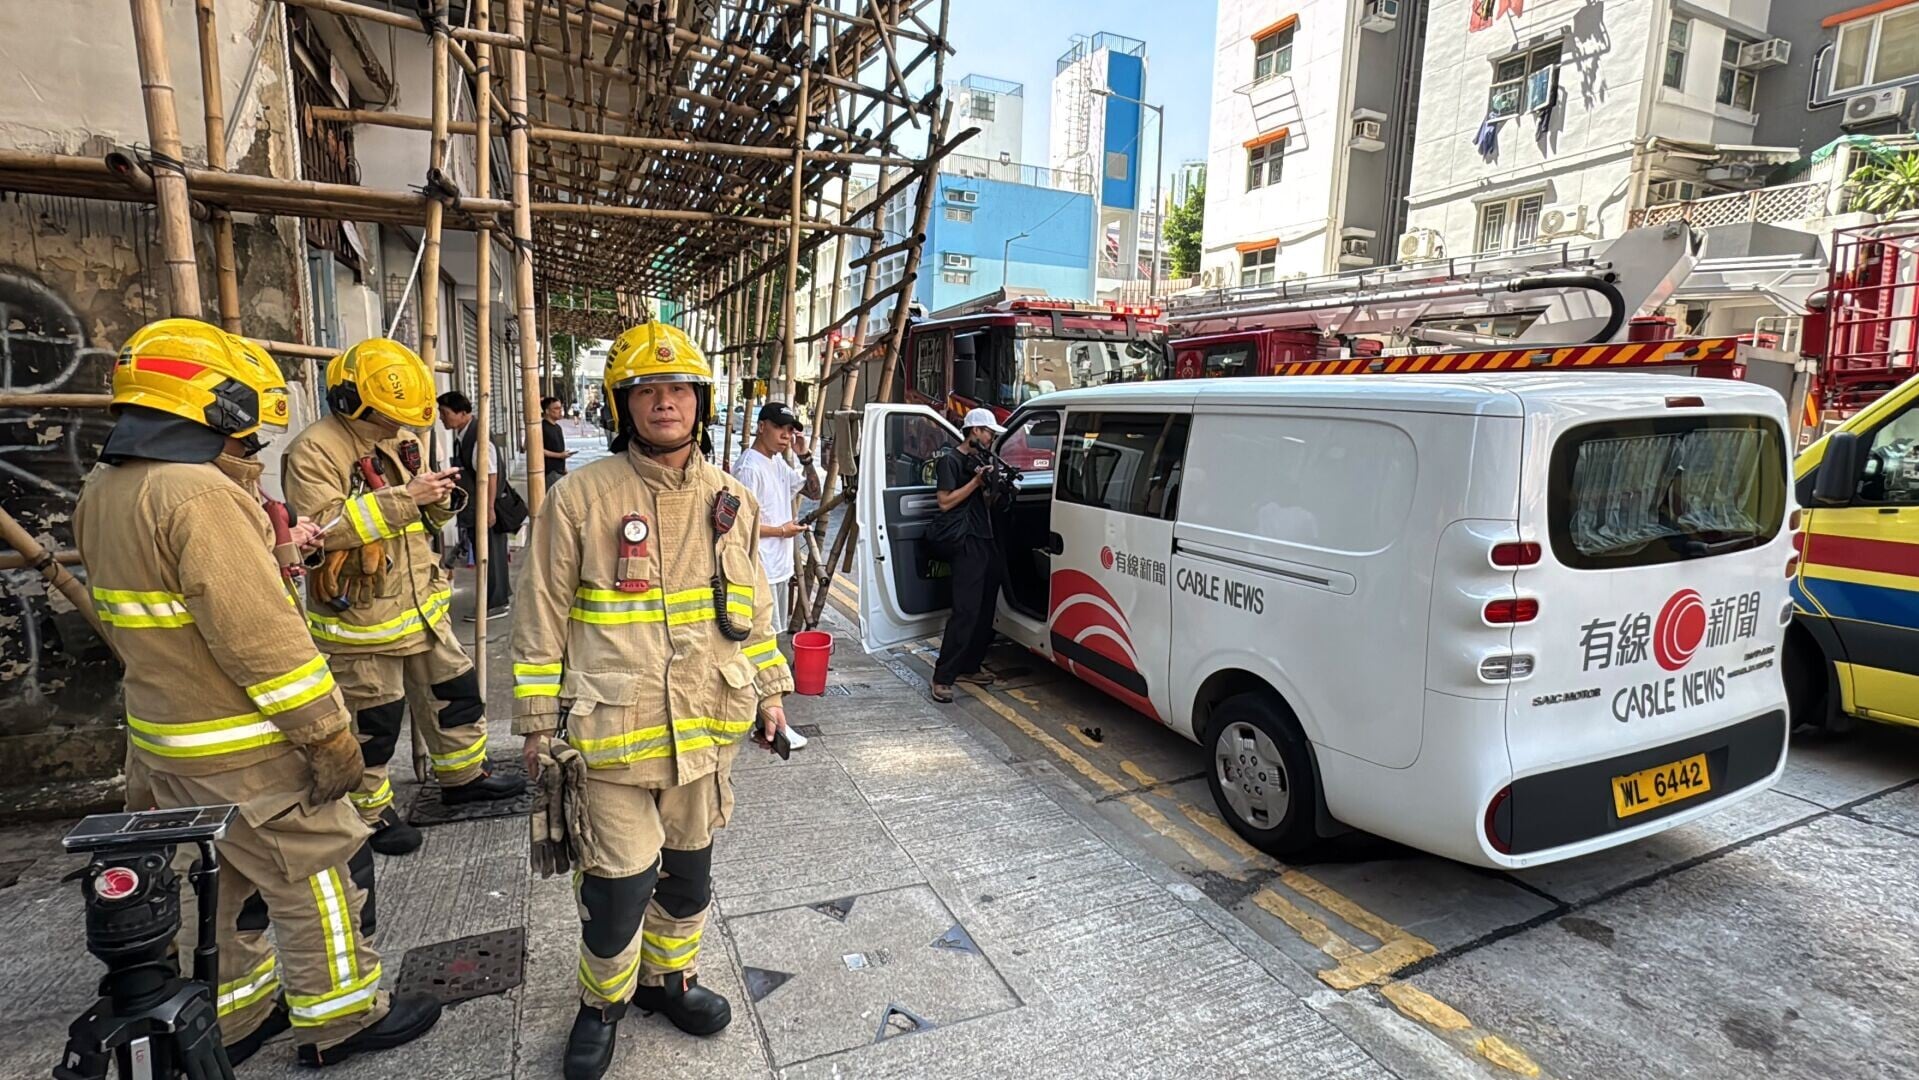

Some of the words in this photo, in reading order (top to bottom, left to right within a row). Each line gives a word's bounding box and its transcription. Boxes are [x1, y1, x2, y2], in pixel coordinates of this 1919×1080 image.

[387, 373, 405, 400] CSW
[1115, 551, 1166, 587] 有線新聞
[1176, 568, 1219, 602] CABLE
[1224, 579, 1264, 615] NEWS
[1579, 612, 1652, 672] 有線
[1706, 591, 1761, 649] 新聞
[1612, 677, 1676, 723] CABLE
[1682, 665, 1726, 708] NEWS
[1620, 779, 1649, 808] WL
[1654, 761, 1703, 798] 6442
